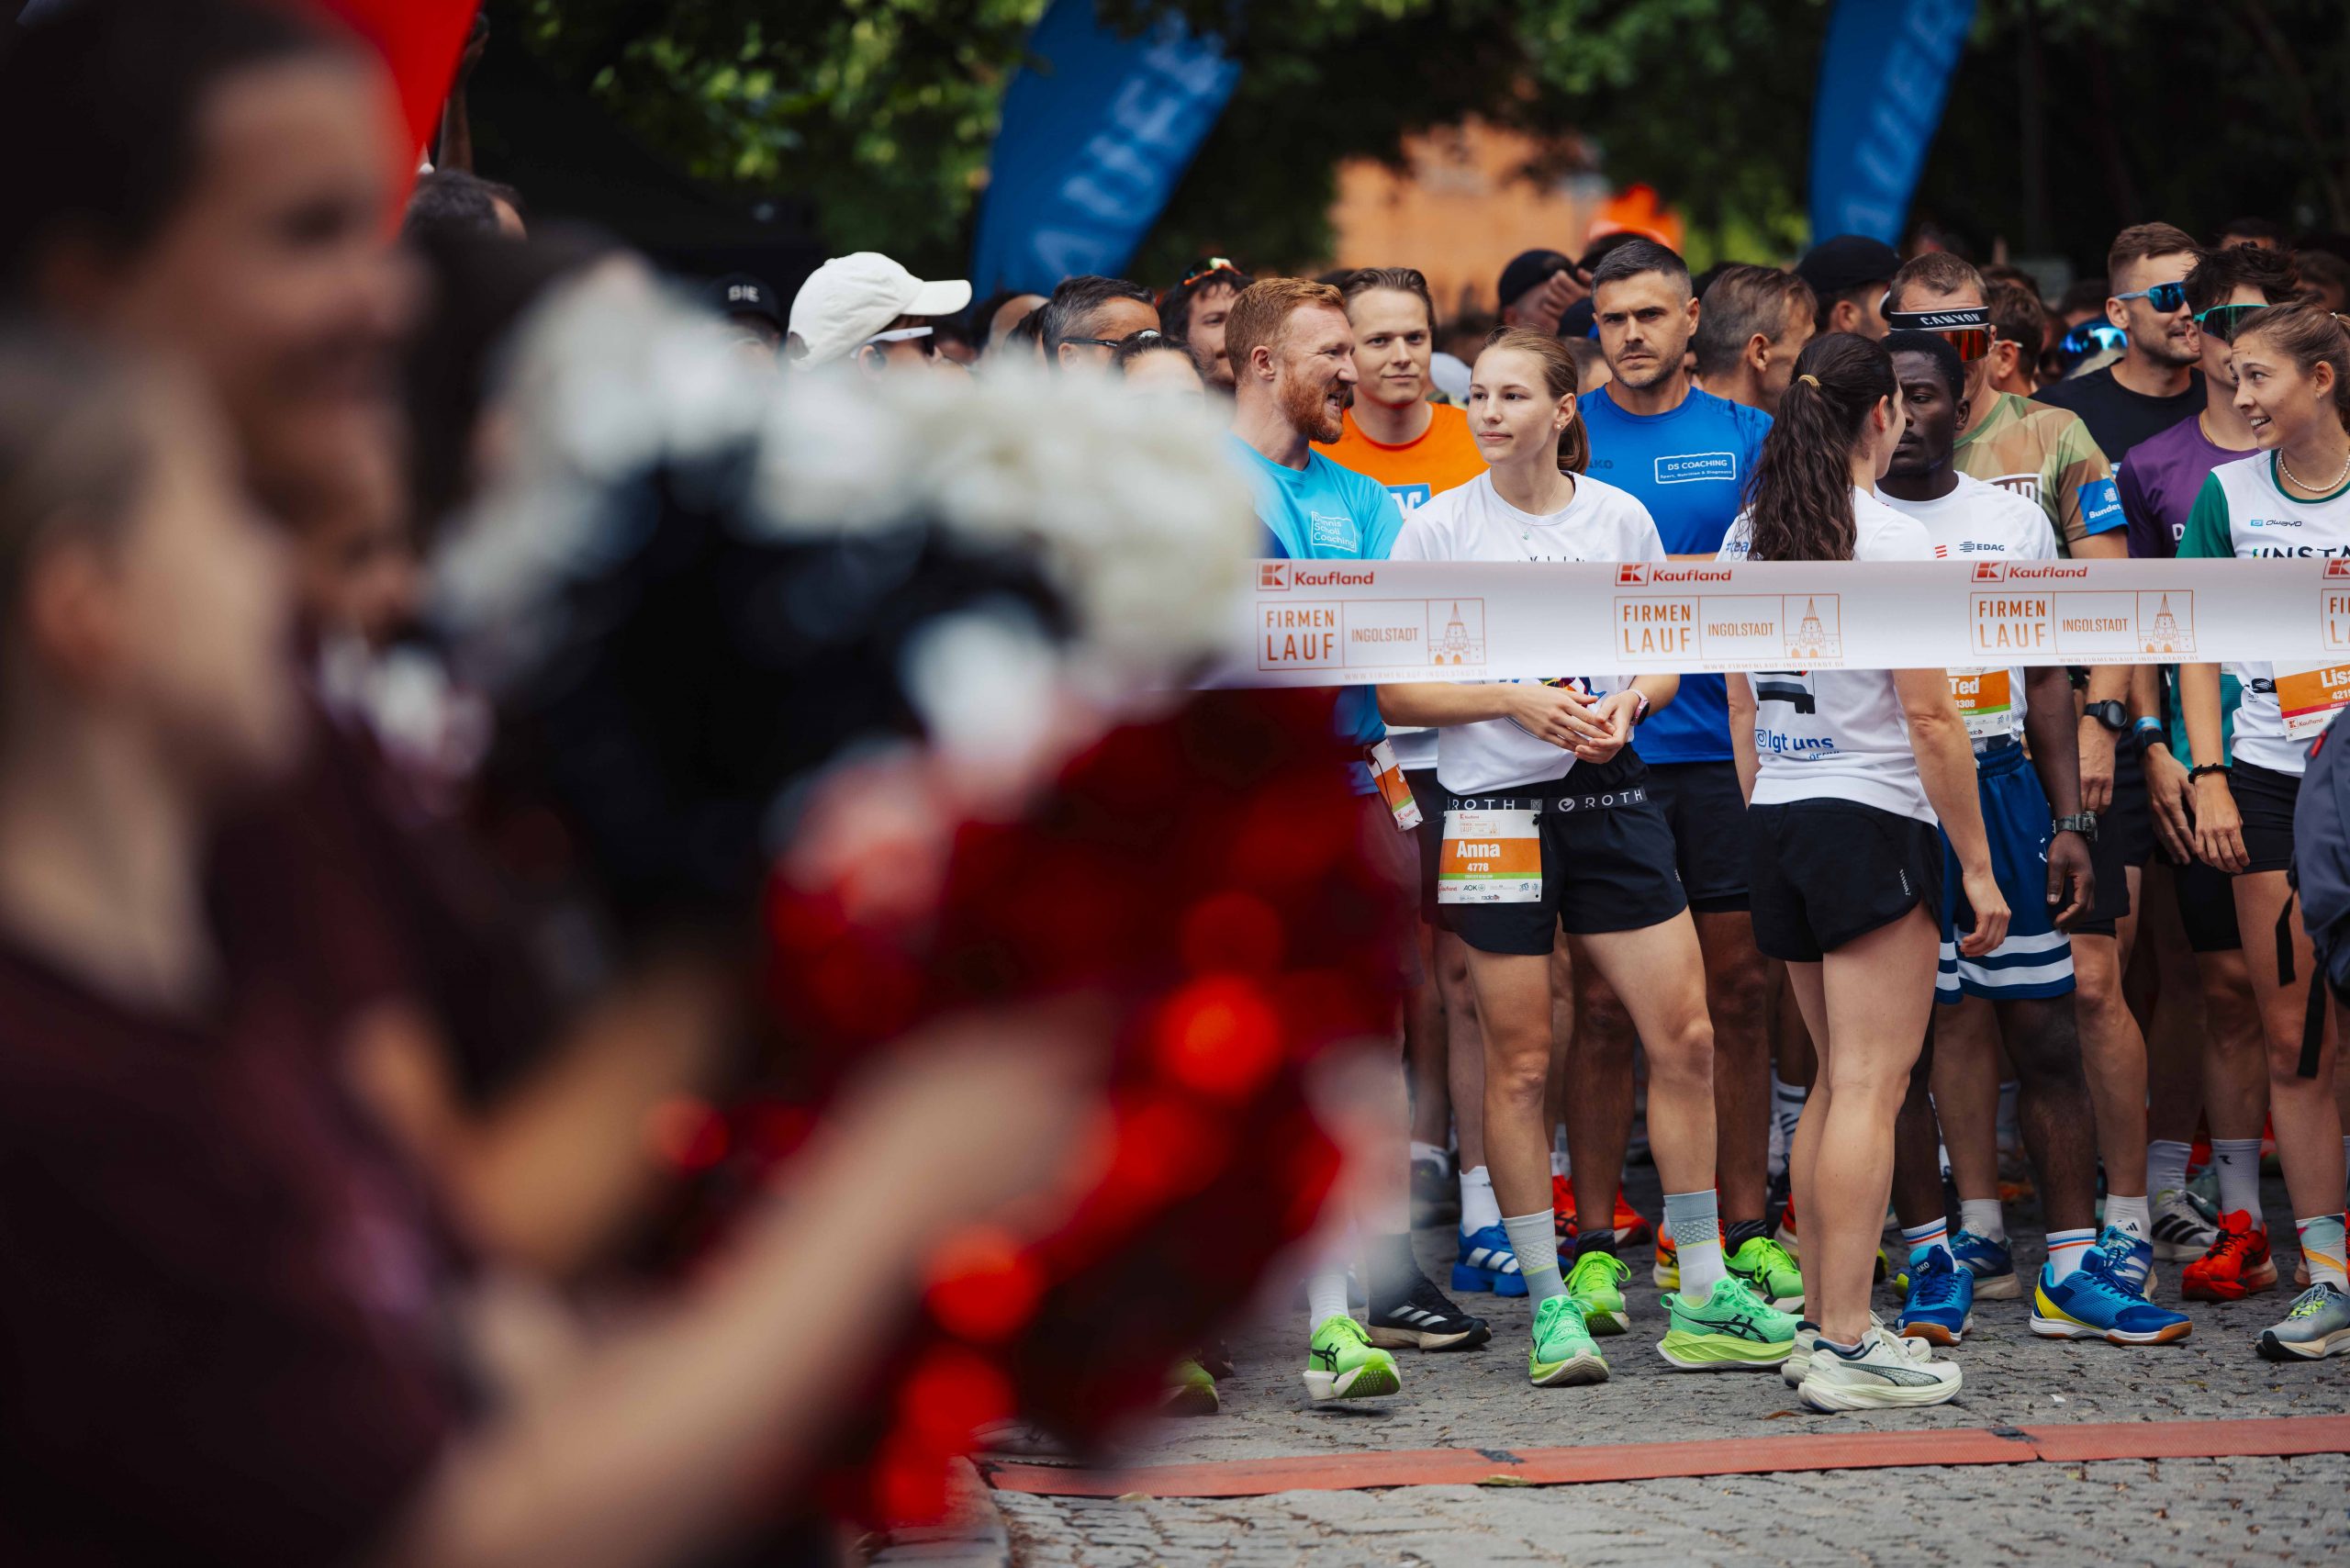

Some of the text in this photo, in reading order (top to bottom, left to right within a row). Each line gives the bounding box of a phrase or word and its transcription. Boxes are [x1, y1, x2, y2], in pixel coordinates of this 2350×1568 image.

[1681, 460, 1728, 469] COACHING
[1314, 532, 1356, 549] Coaching
[1976, 543, 2005, 552] EDAG
[1294, 571, 1374, 586] Kaufland
[1653, 569, 1732, 582] Kaufland
[2009, 566, 2088, 578] Kaufland
[1623, 605, 1691, 622] FIRMEN
[1978, 600, 2046, 618] FIRMEN
[2330, 597, 2350, 614] FI
[1267, 610, 1335, 628] FIRMEN
[2063, 618, 2129, 633] INGOLSTADT
[1351, 627, 1418, 643] INGOLSTADT
[1708, 622, 1774, 637] INGOLSTADT
[1979, 622, 2046, 648] LAUF
[2330, 621, 2350, 644] L
[1267, 633, 1335, 661] LAUF
[1624, 627, 1691, 653] LAUF
[1948, 677, 1980, 695] Ted
[1793, 737, 1834, 751] uns
[1452, 799, 1515, 811] ROTH
[1585, 790, 1643, 808] ROTH
[1456, 840, 1501, 858] Anna
[1467, 863, 1489, 872] 4778
